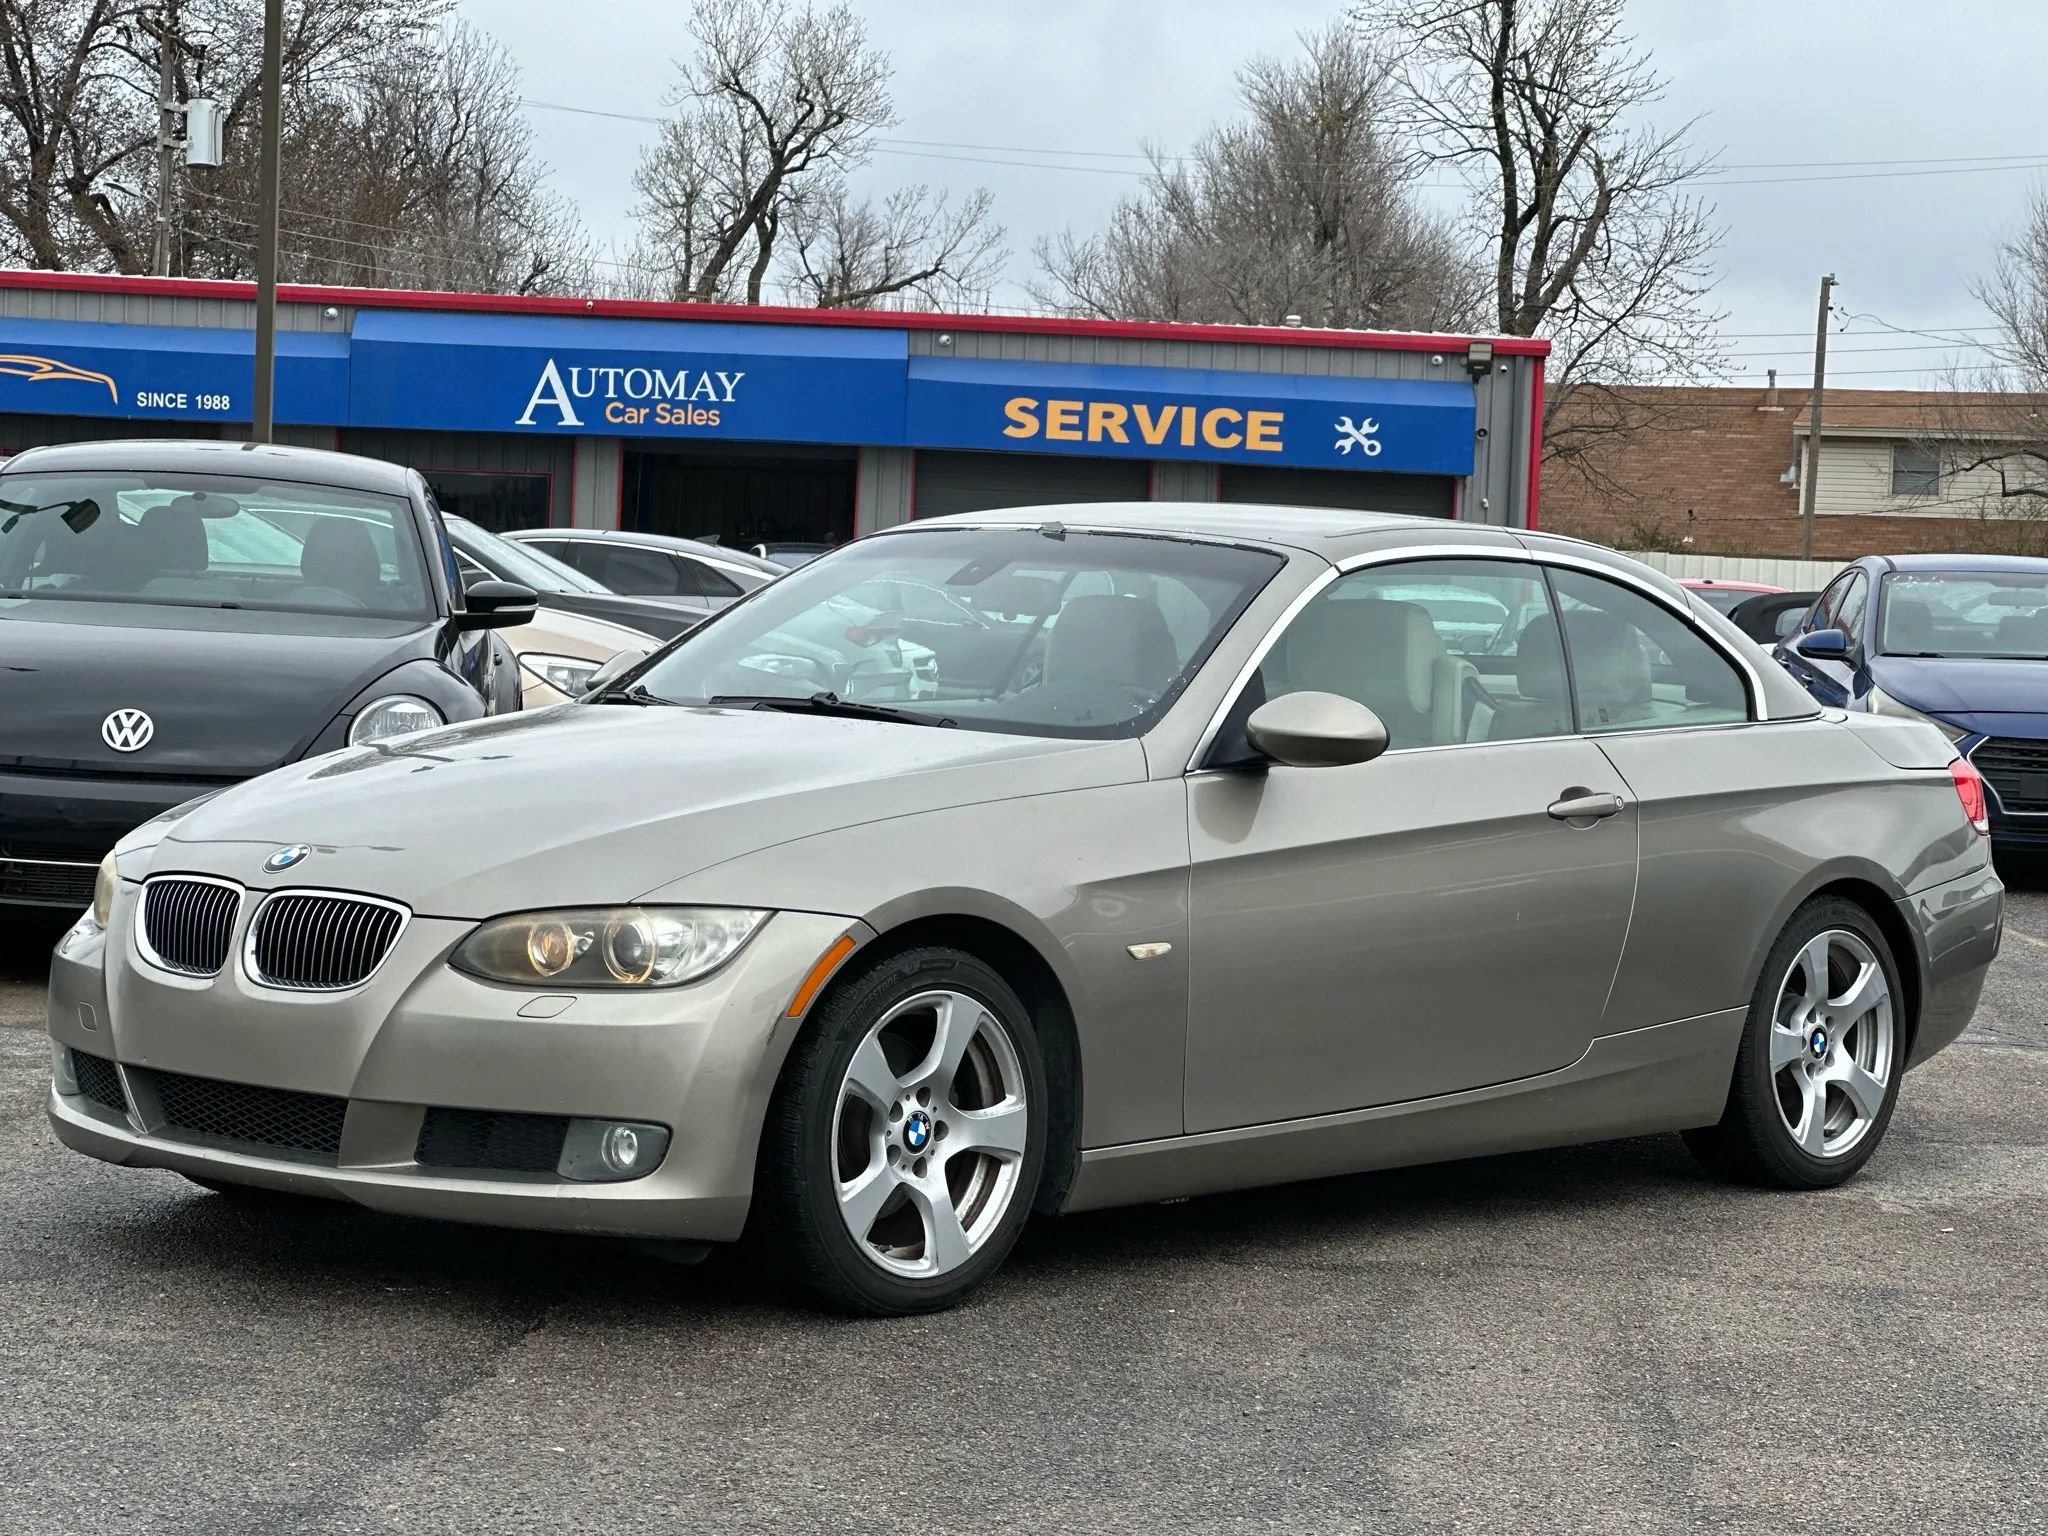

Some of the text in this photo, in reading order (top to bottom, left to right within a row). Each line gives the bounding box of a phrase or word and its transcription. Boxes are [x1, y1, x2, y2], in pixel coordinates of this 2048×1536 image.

[136, 391, 231, 411] SINCE 1988
[515, 358, 746, 426] AUTOMAY
[605, 401, 721, 427] Car Sales
[1002, 397, 1285, 452] SERVICE
